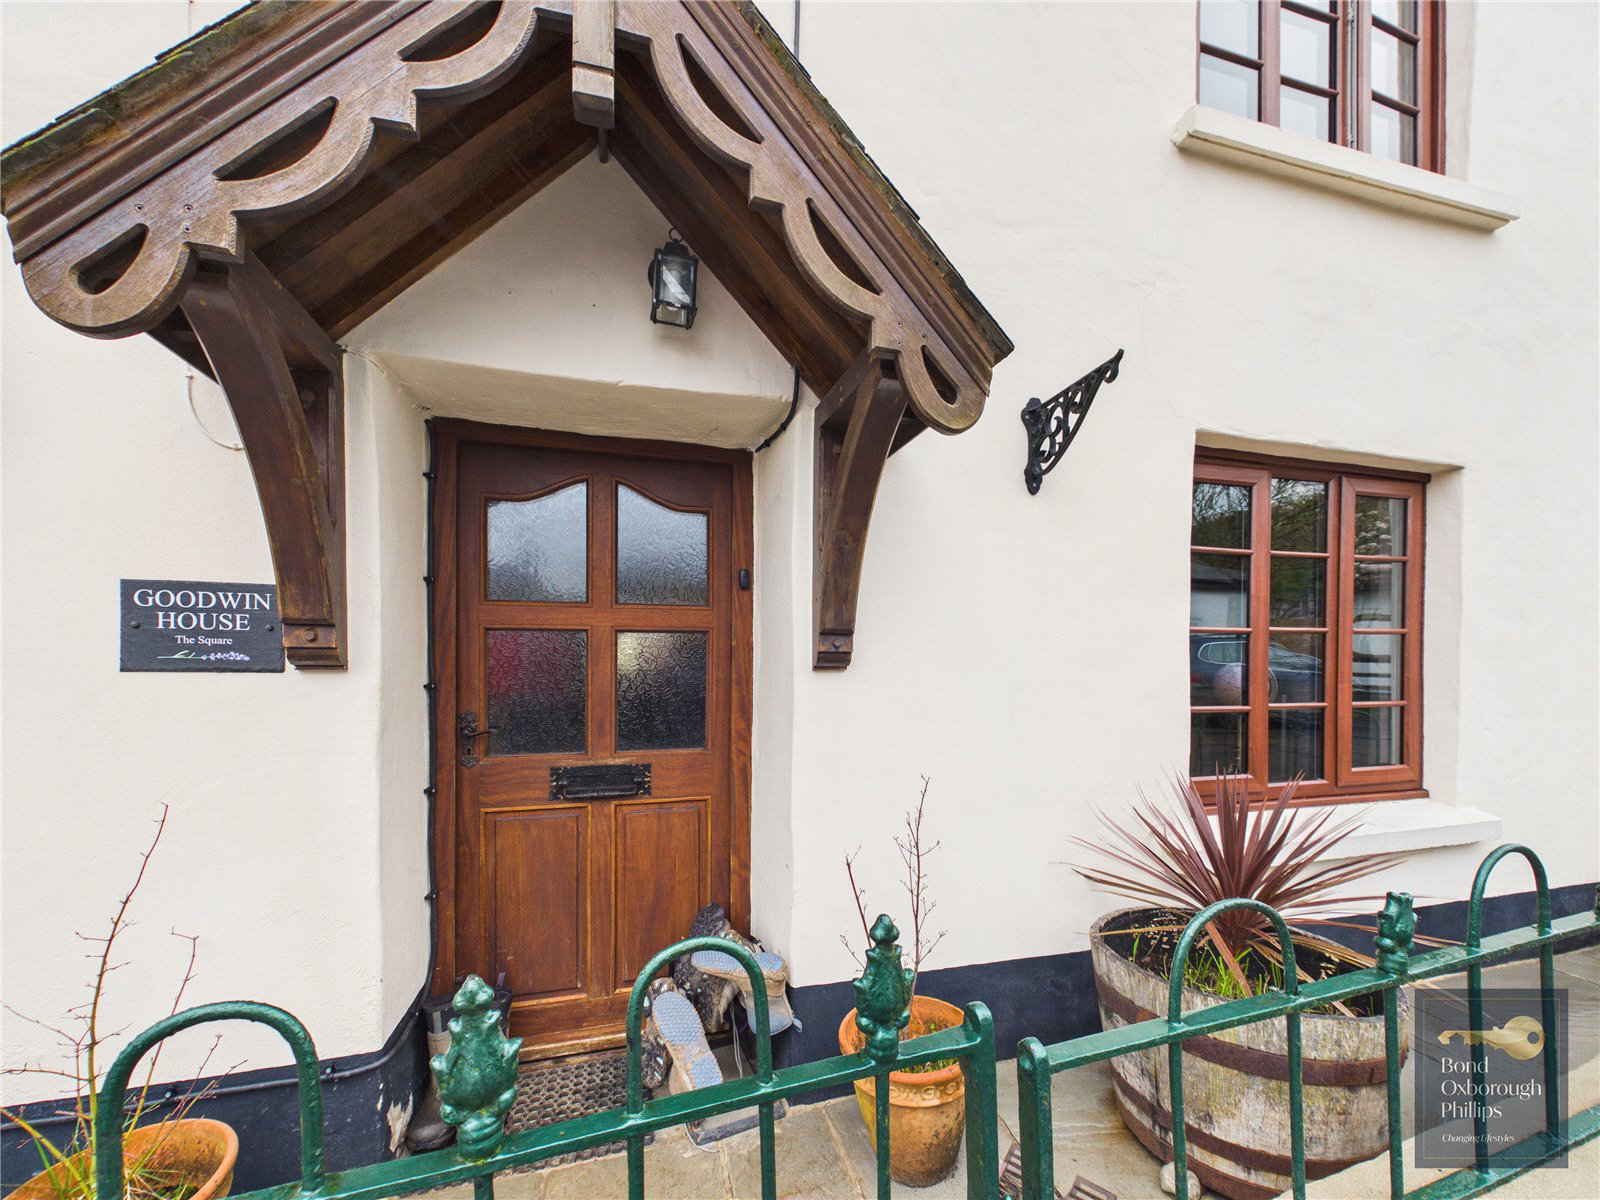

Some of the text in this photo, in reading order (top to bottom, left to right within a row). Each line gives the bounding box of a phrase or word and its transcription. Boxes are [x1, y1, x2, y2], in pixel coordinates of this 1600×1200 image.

[133, 589, 272, 610] GOODWIN
[156, 611, 251, 631] HOUSE
[175, 635, 233, 646] The Square
